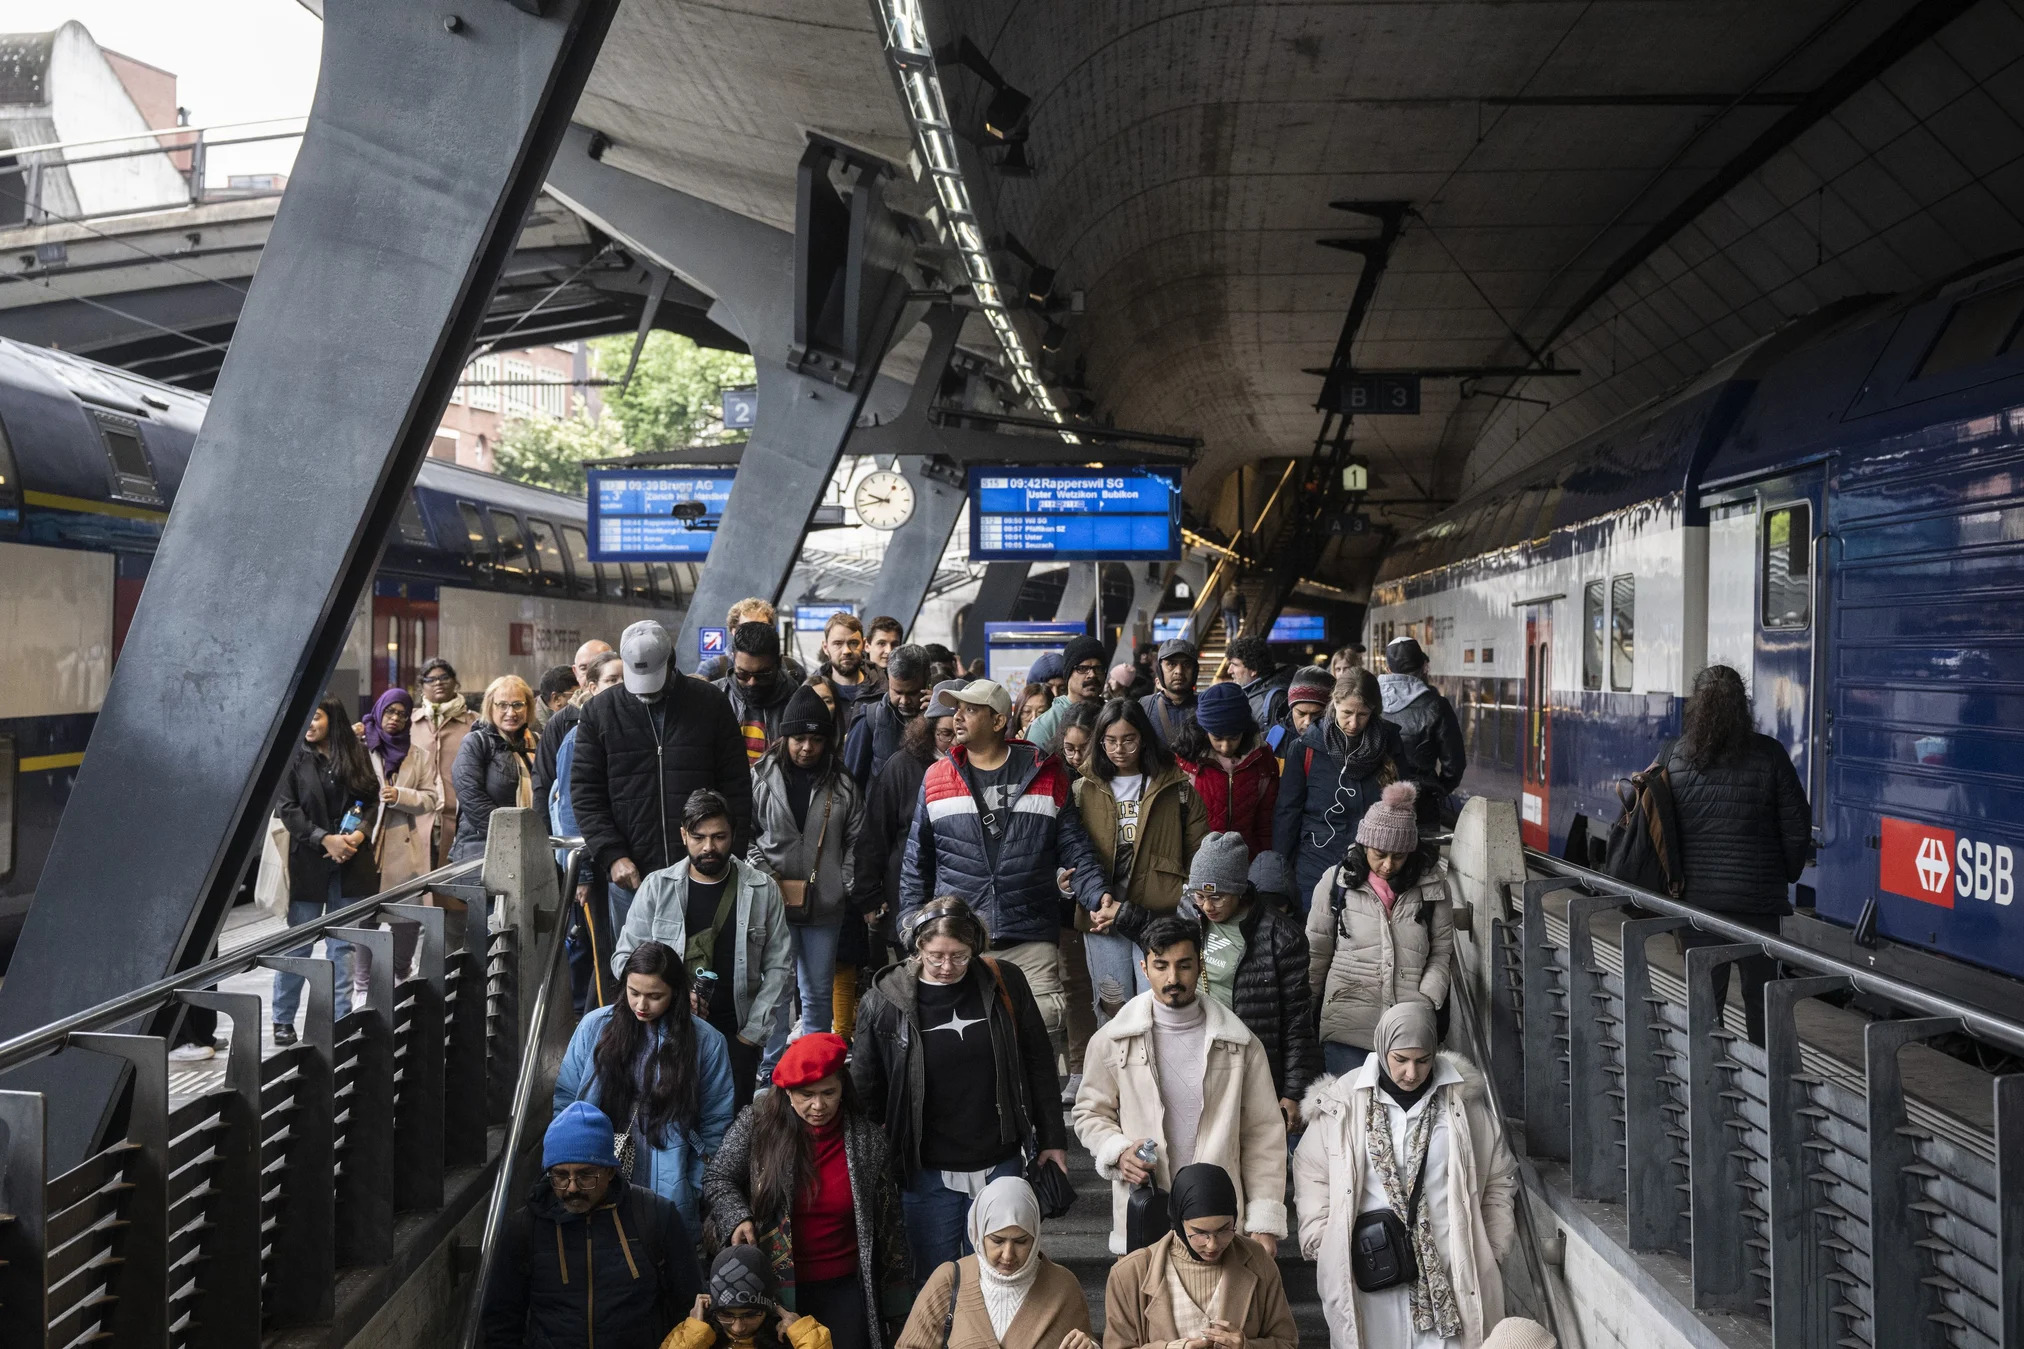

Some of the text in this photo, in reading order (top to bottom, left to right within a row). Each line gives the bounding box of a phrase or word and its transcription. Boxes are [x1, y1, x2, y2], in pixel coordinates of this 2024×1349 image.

[1351, 387, 1407, 407] B 3
[735, 402, 750, 423] 2
[660, 480, 693, 493] Brugg
[695, 480, 713, 490] AG
[1010, 478, 1040, 488] 09:42
[1041, 478, 1104, 490] Rapperswil
[1106, 478, 1124, 488] SG
[1351, 469, 1357, 488] 1
[1029, 490, 1139, 499] Uster Wetzikon Bubikon
[1955, 837, 2014, 906] SBB
[1204, 956, 1227, 969] ARMANI
[735, 1290, 773, 1310] Colum
